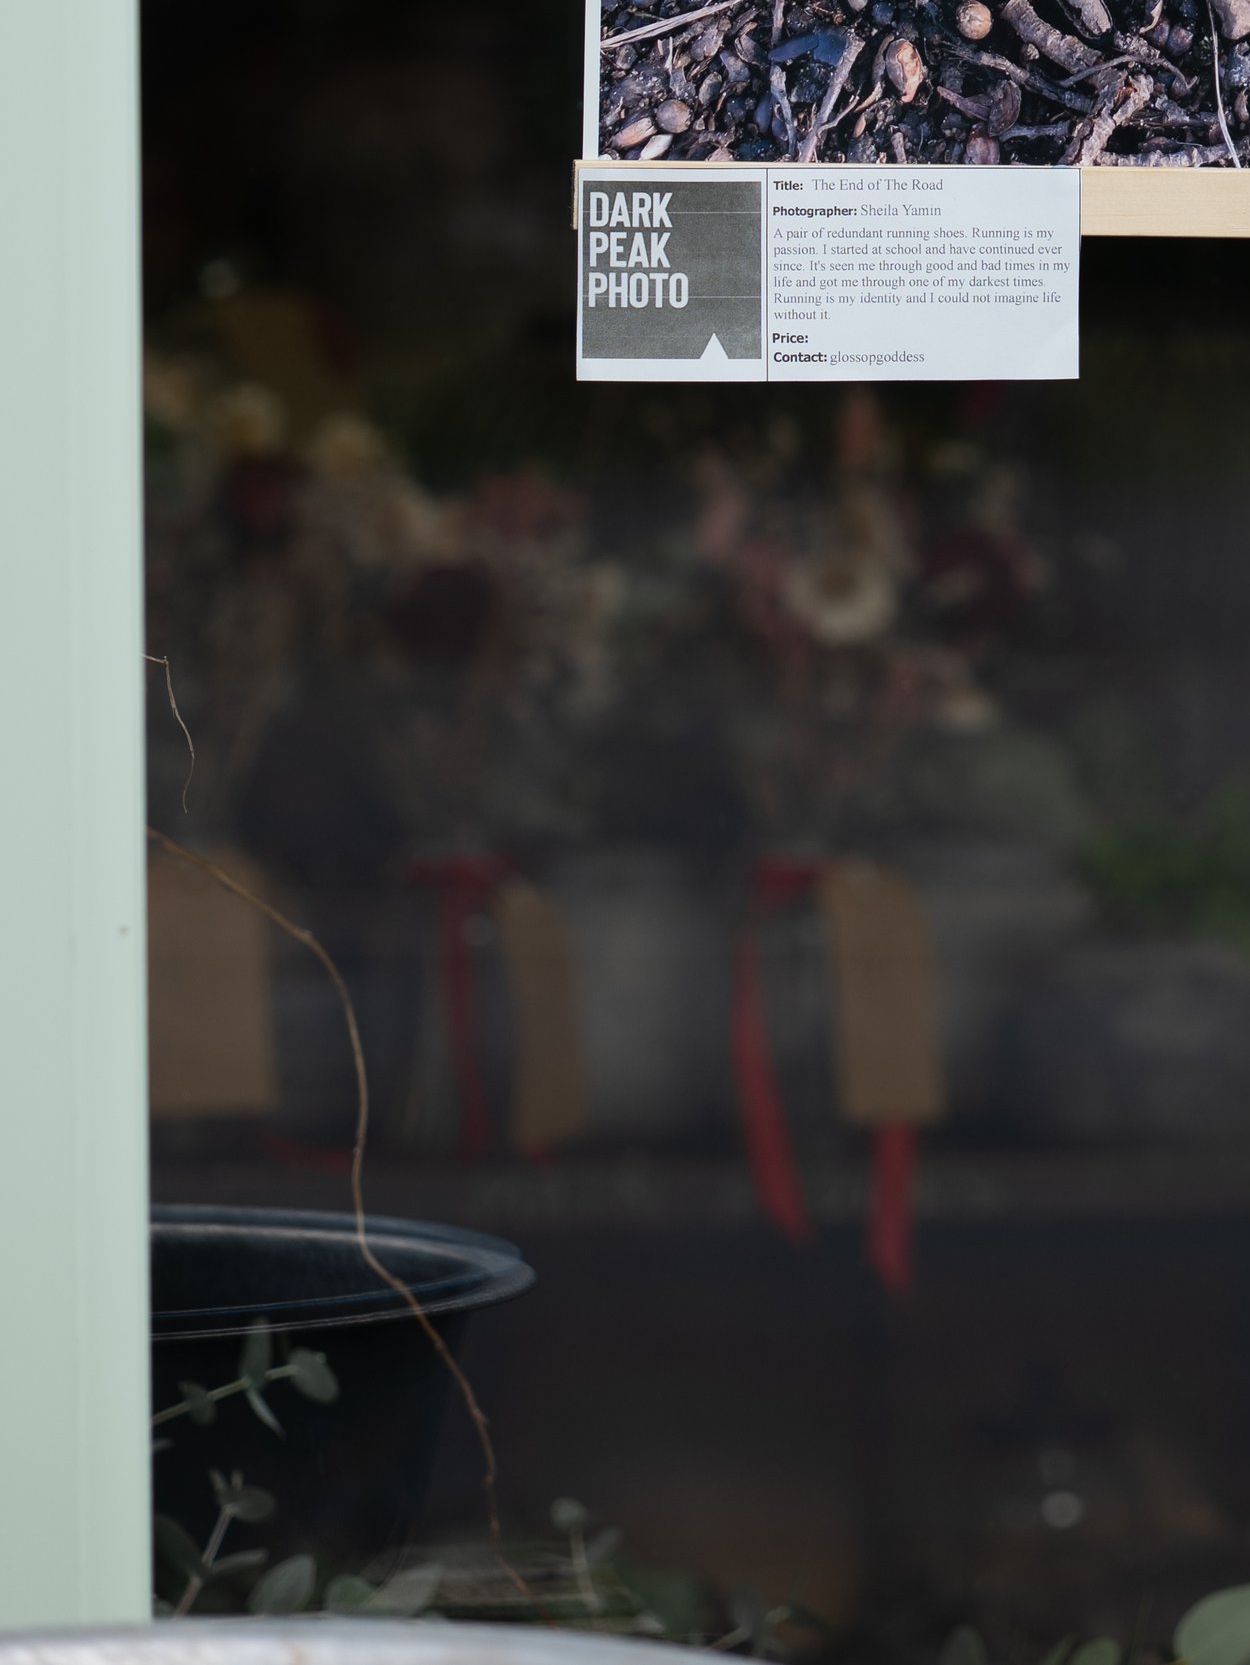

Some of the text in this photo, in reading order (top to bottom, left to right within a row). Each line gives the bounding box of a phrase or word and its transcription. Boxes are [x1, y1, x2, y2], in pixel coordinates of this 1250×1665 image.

[772, 179, 944, 191] Title: The End of The Road
[589, 191, 673, 228] DARK
[772, 204, 942, 218] Photographer: Sheila Yamin
[773, 227, 1054, 241] A pair of redundant running shoes. Running is my
[589, 231, 671, 268] PEAK
[773, 244, 1062, 257] passion. I started at school and have continued ever
[773, 259, 1070, 274] since. It's seen me through good and bad times in my
[773, 276, 1046, 290] life and got me through one of my darkest times.
[588, 272, 689, 309] PHOTO
[773, 292, 1061, 306] Running is my identity and I could not imagine life
[774, 308, 831, 320] without it.
[772, 333, 809, 344] Price:
[773, 351, 925, 365] Contact: glossopgoddess
